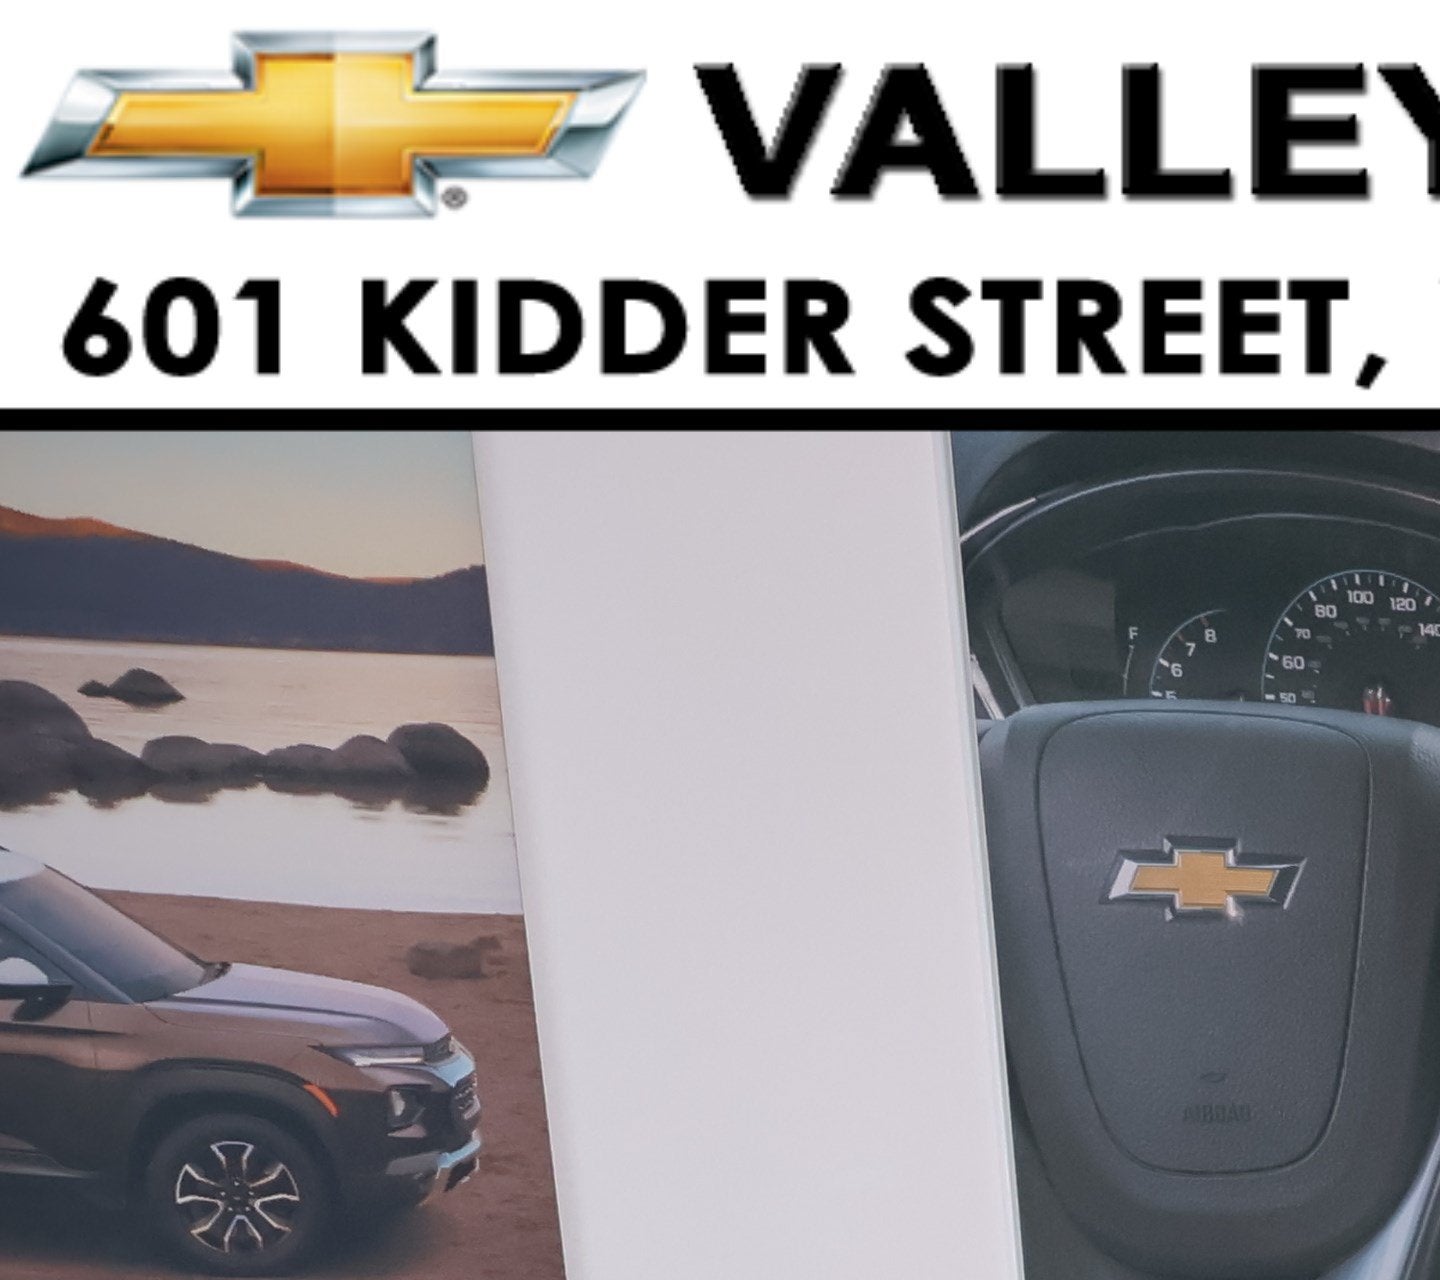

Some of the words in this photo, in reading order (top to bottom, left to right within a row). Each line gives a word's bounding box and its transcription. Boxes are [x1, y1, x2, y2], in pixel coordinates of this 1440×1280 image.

[1347, 589, 1374, 605] 100
[1390, 596, 1417, 613] 120
[1128, 627, 1138, 642] F
[1204, 629, 1217, 644] 8
[1295, 628, 1311, 640] 70
[1185, 643, 1196, 657] 7
[1282, 655, 1305, 670] 60
[1170, 663, 1183, 678] 6
[1279, 692, 1297, 704] 50
